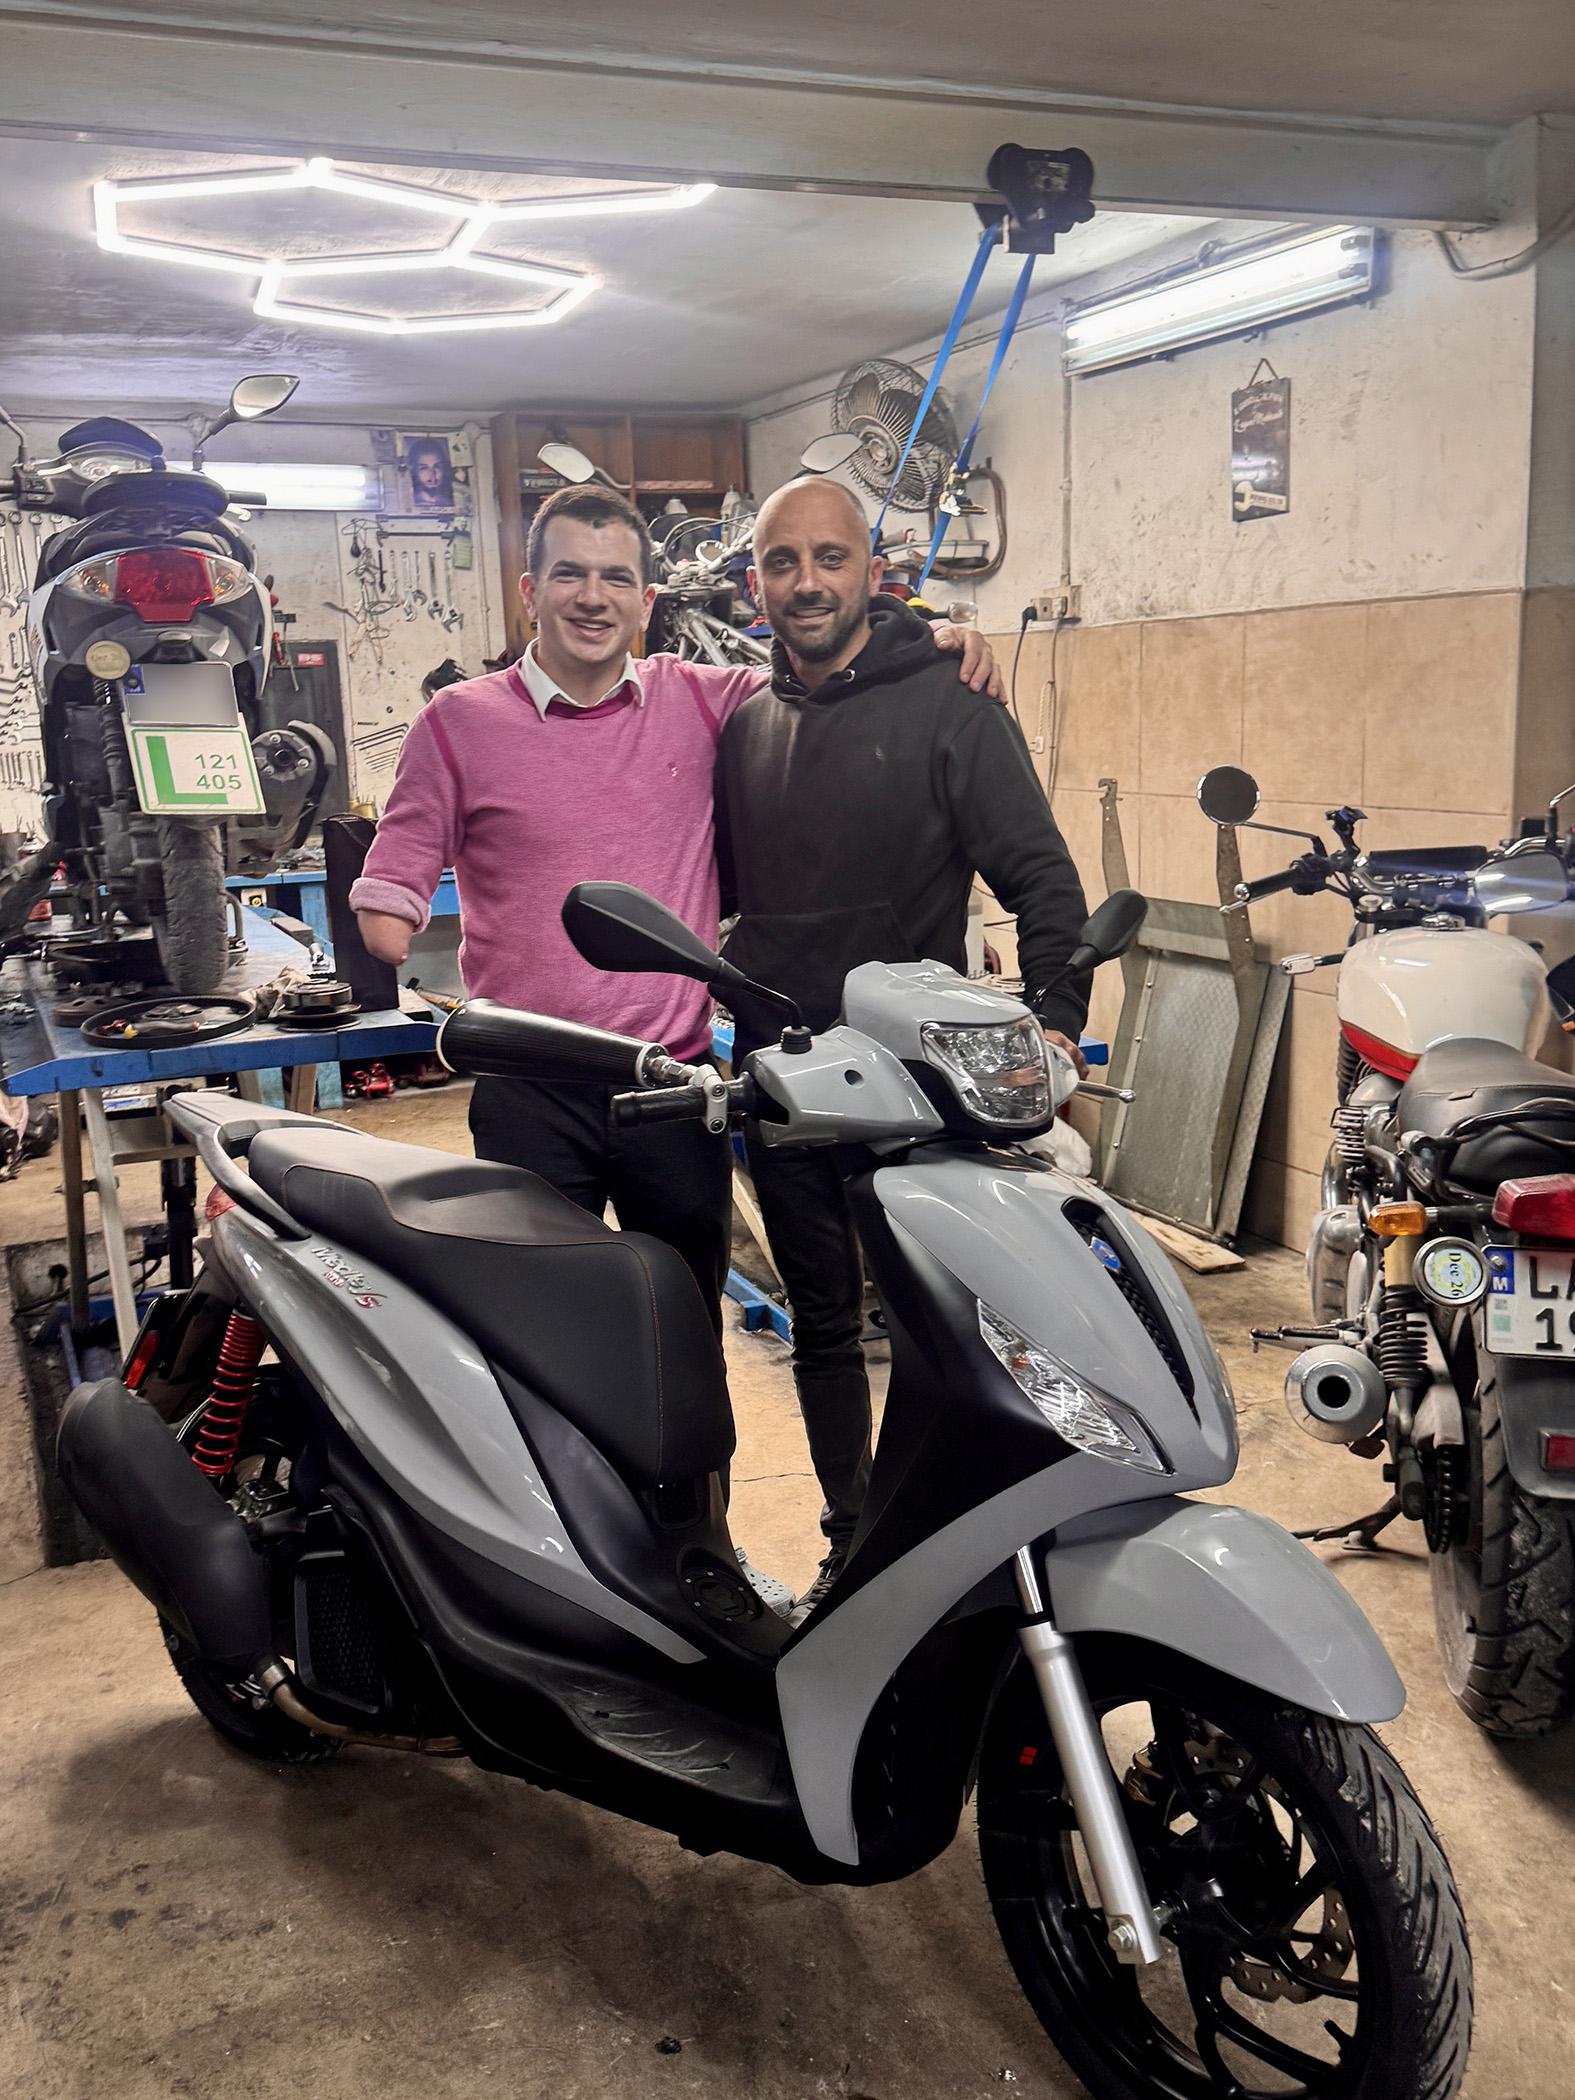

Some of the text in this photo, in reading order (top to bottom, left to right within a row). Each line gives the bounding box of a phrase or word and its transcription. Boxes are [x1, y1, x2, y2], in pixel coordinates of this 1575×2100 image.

[145, 735, 228, 805] L
[195, 754, 237, 769] 121
[196, 774, 242, 790] 405
[1449, 1252, 1464, 1297] Dec 26
[1492, 1276, 1509, 1291] M
[1529, 1256, 1575, 1300] L
[1536, 1308, 1575, 1351] 1
